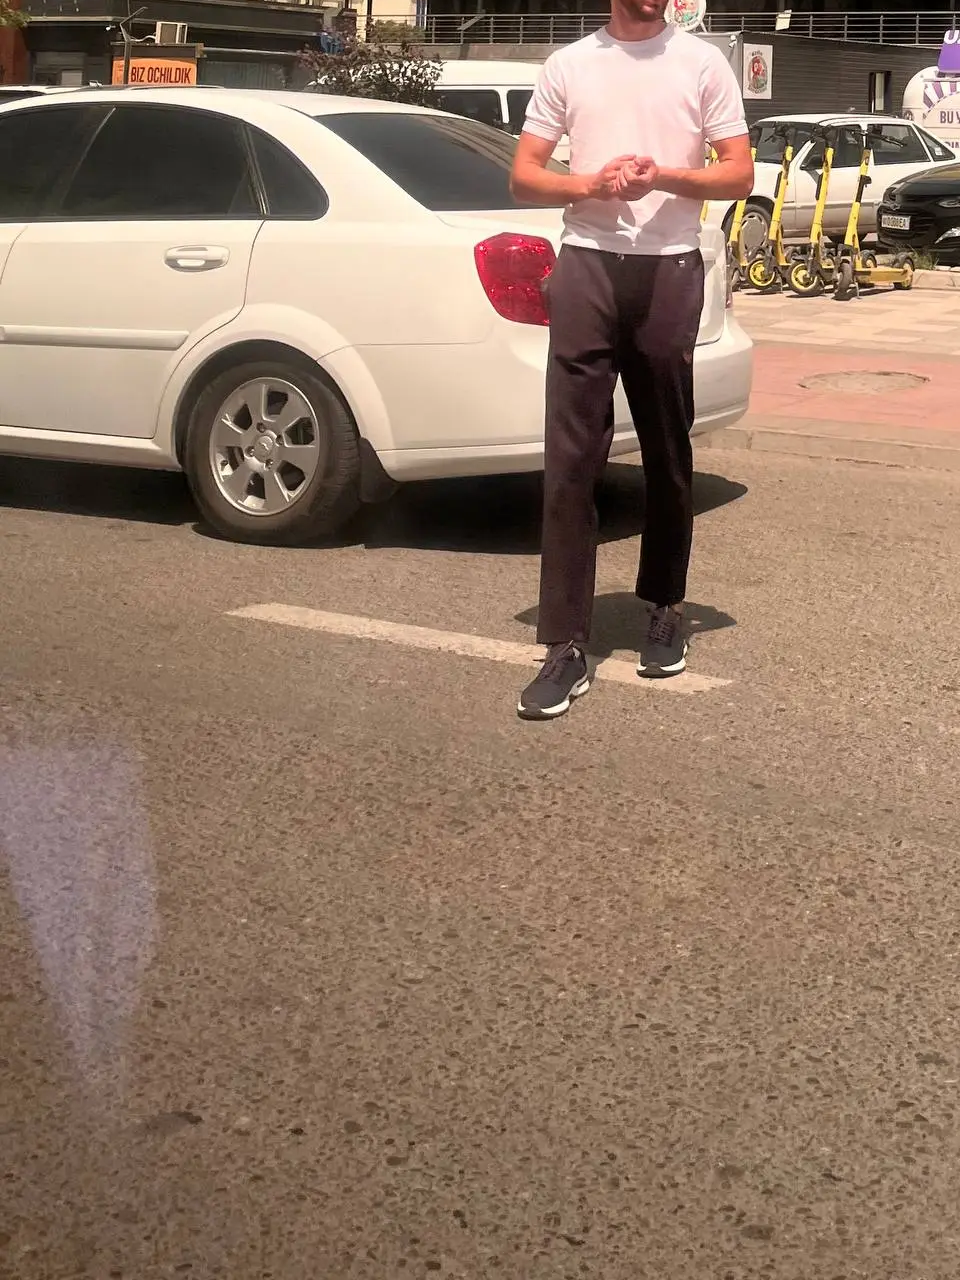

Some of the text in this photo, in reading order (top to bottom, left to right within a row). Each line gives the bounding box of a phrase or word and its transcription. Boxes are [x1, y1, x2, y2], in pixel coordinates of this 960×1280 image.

[130, 66, 192, 84] BIZ OCHILDIK
[940, 111, 955, 124] BU
